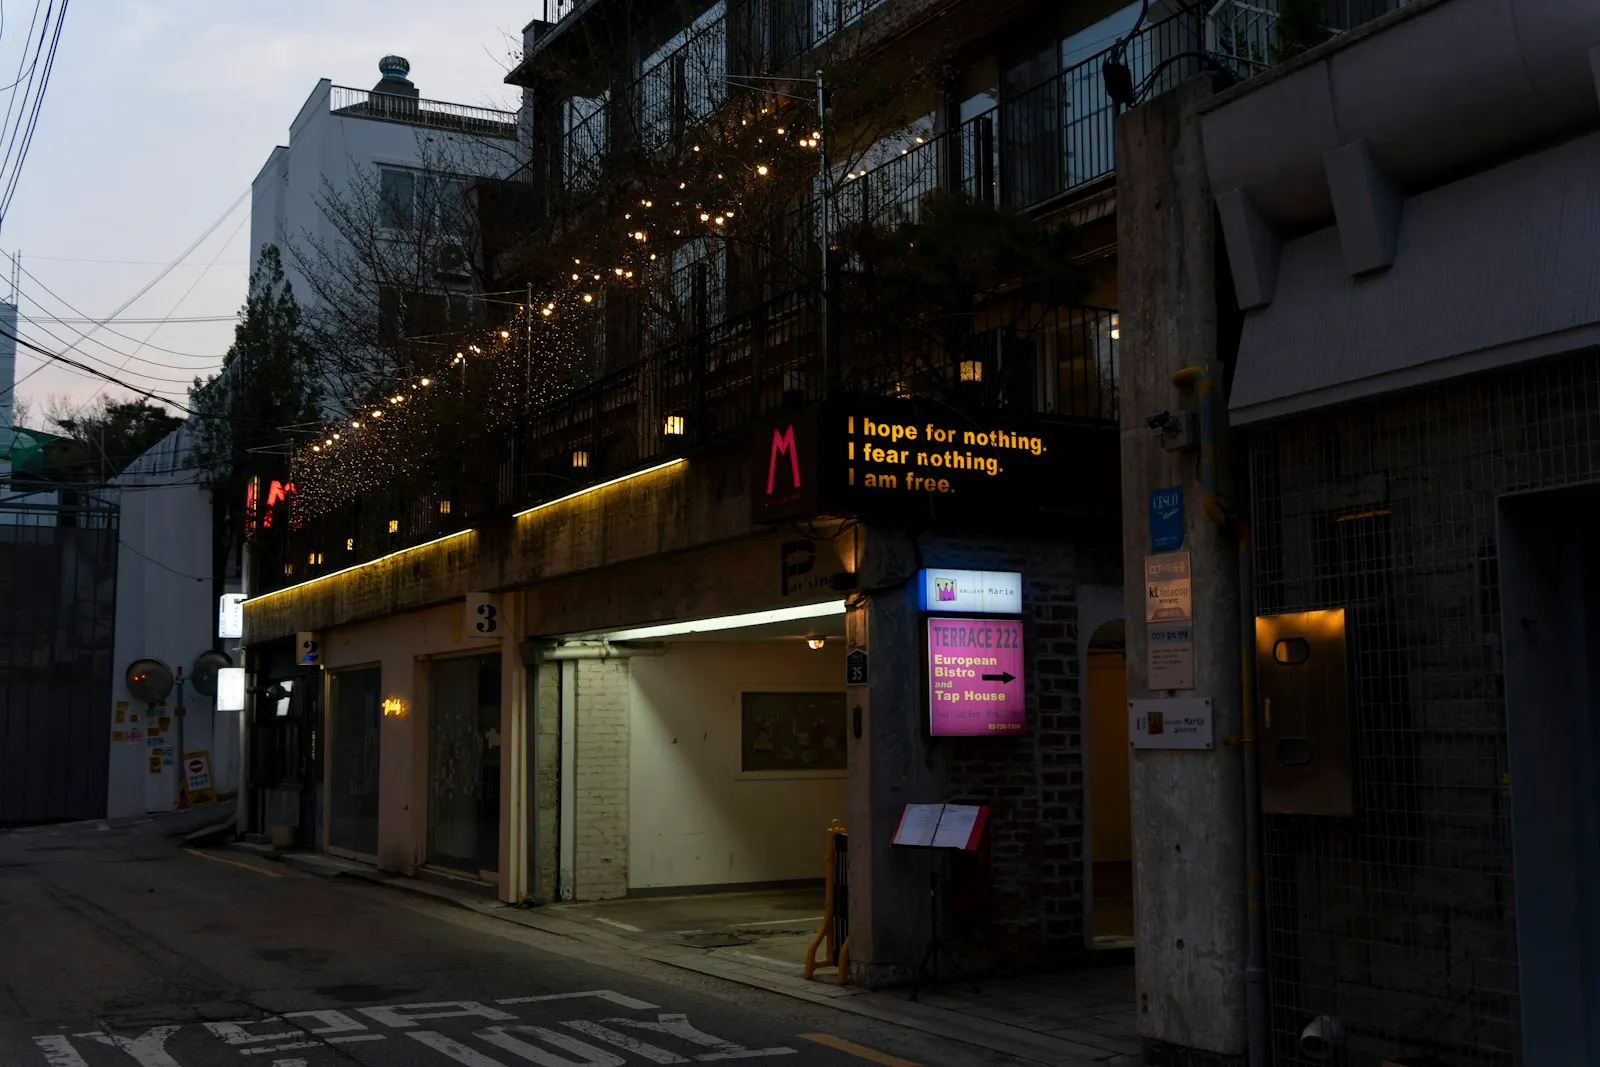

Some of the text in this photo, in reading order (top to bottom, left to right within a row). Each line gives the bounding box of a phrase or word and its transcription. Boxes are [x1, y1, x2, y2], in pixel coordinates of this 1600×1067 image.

[848, 415, 1048, 456] I hope for nothing.
[763, 422, 802, 497] M
[848, 441, 1004, 476] I fear nothing.
[848, 467, 956, 494] I am free.
[1152, 491, 1179, 510] CESCO
[988, 587, 1015, 596] Marie
[1149, 586, 1159, 598] kt
[476, 604, 497, 633] 3
[933, 626, 1019, 649] TERRACE 222
[303, 640, 319, 662] 2
[934, 654, 998, 668] European
[851, 666, 863, 681] 35
[934, 666, 976, 678] Bistro
[934, 680, 953, 689] and
[935, 690, 1006, 703] Tap House
